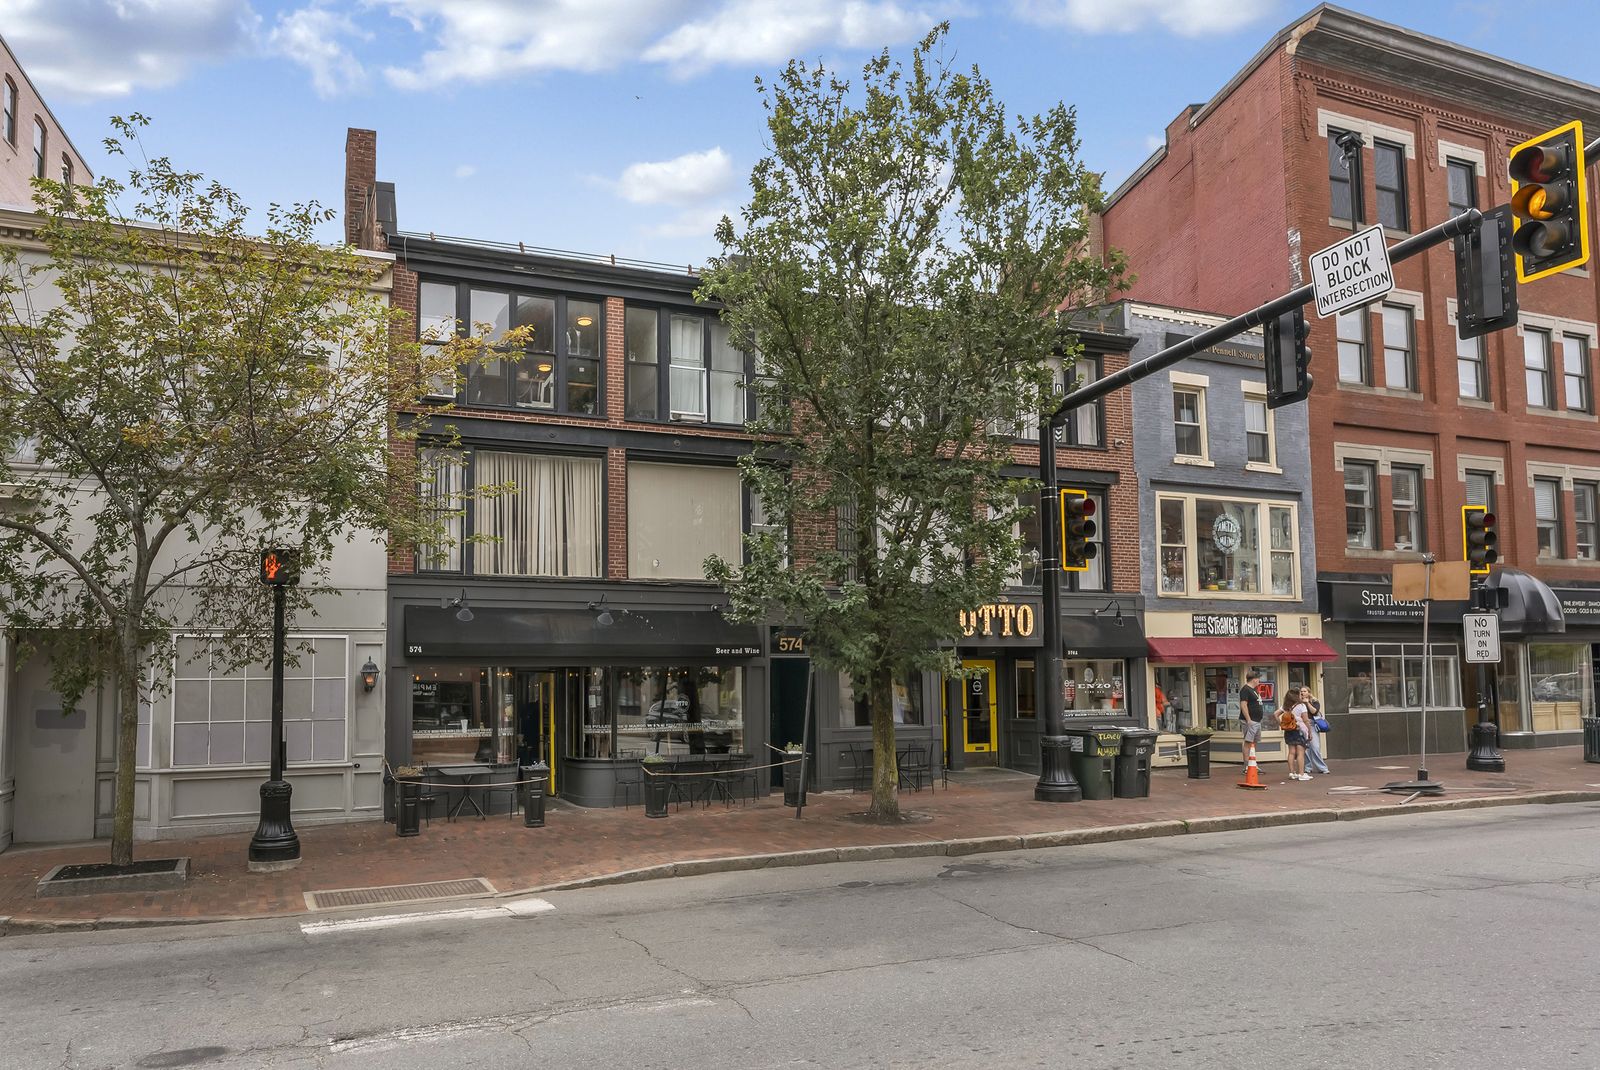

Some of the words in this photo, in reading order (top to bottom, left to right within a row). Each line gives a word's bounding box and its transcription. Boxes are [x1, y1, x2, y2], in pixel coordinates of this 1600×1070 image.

[1322, 252, 1339, 271] DO
[1345, 236, 1371, 260] NOT
[1327, 257, 1372, 288] BLOCK
[1320, 271, 1389, 308] INTERSECTION
[960, 604, 1034, 637] OTTO
[1474, 618, 1488, 628] NO
[779, 637, 803, 651] 574
[1478, 640, 1487, 648] ON
[1476, 650, 1490, 658] RED
[1257, 684, 1272, 699] EN
